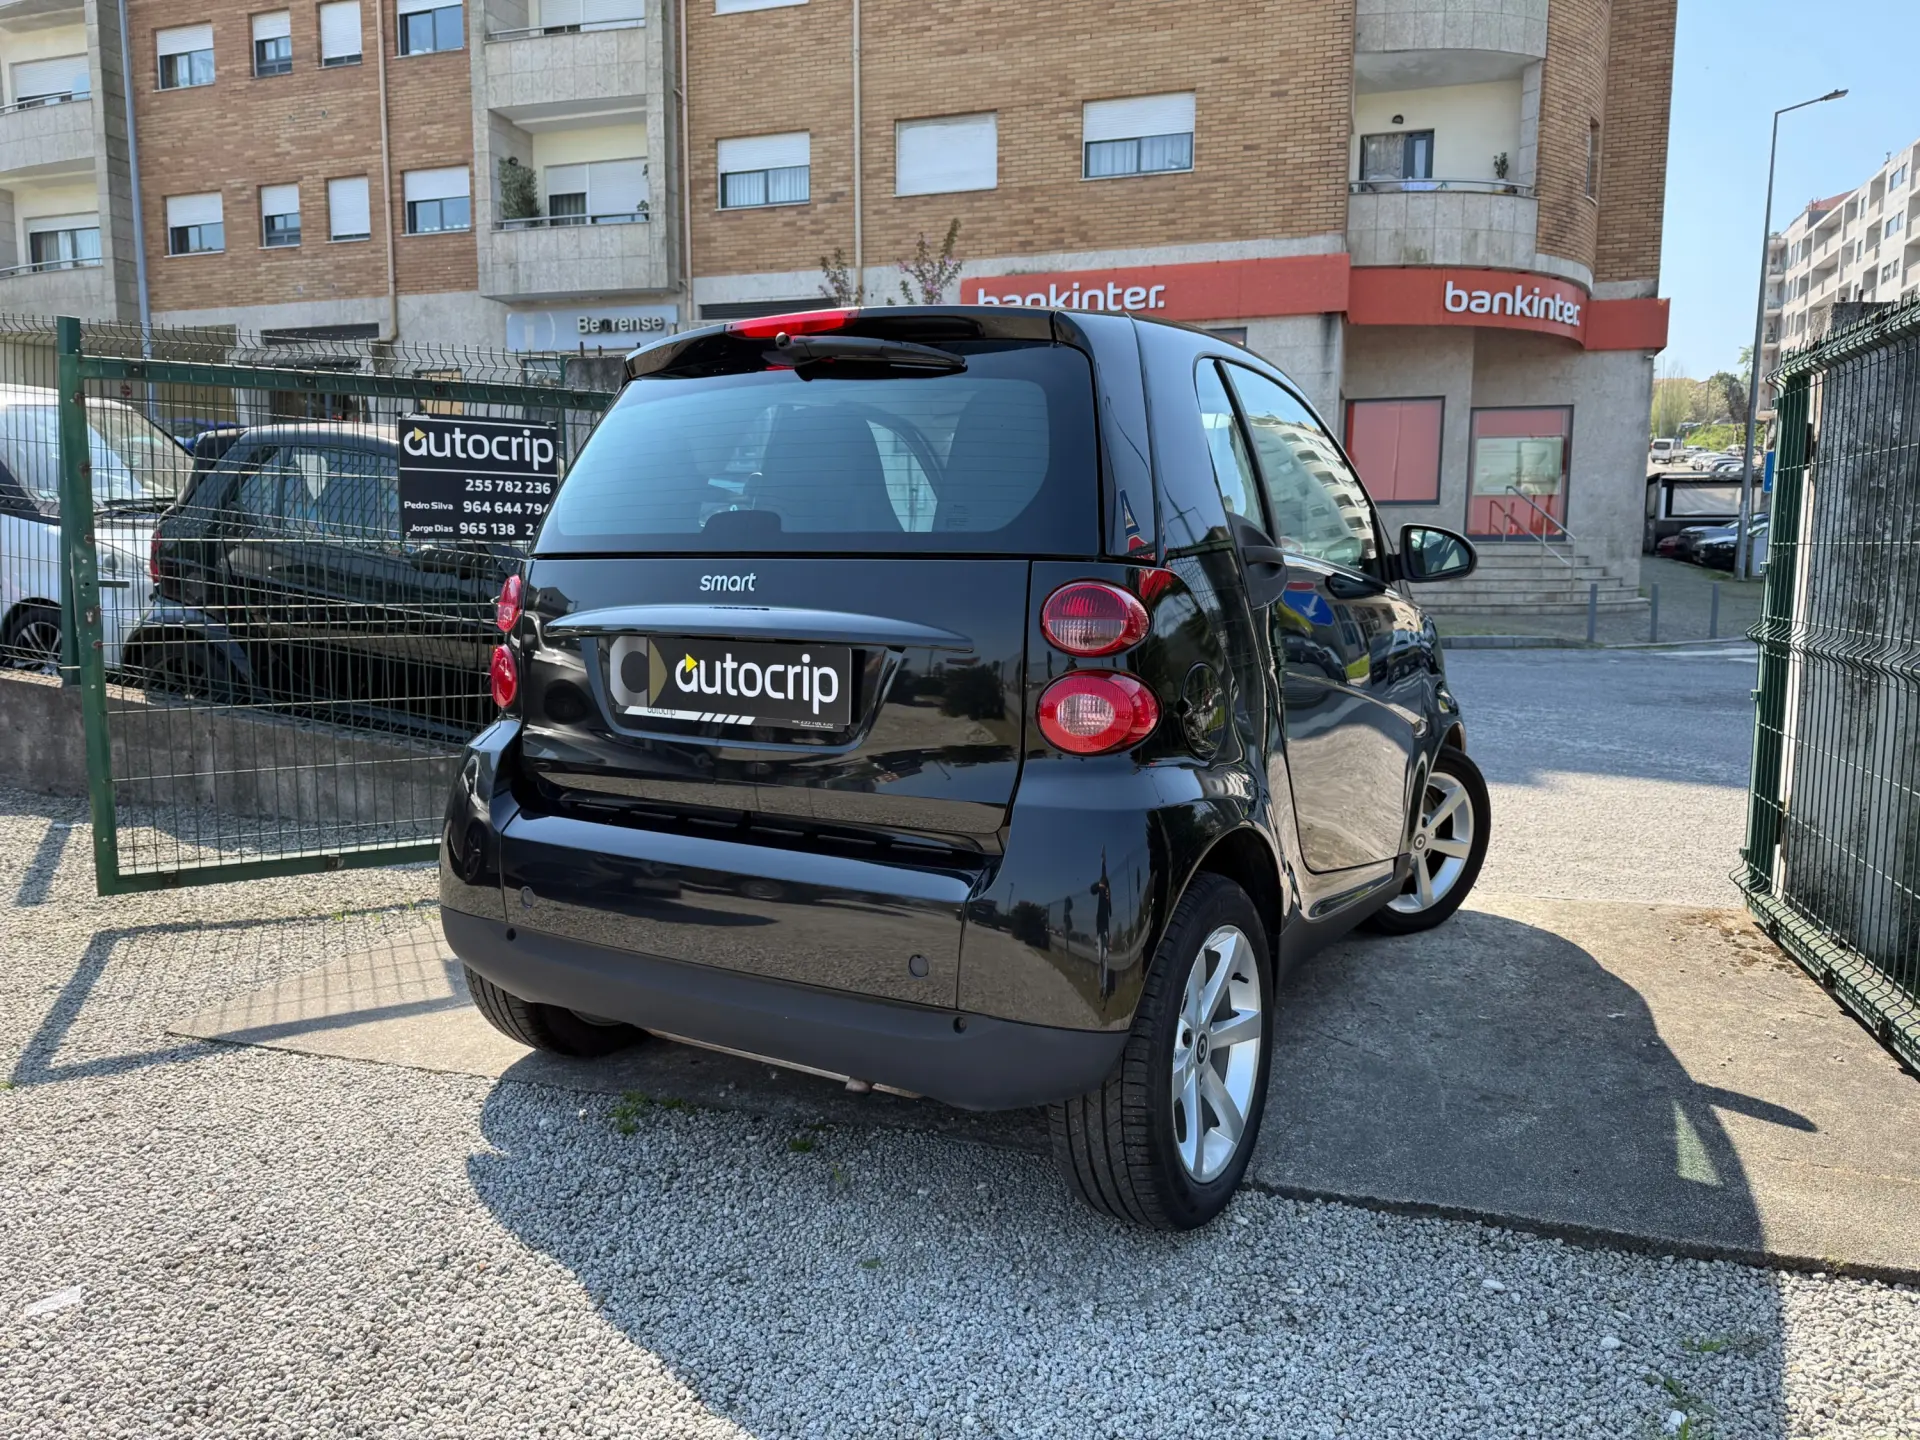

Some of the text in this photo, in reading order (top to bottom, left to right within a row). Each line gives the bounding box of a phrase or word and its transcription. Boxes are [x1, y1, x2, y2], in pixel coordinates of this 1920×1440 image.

[1444, 280, 1581, 326] bankinter.
[403, 427, 554, 471] autocrip
[465, 479, 551, 494] 255 782 236
[404, 501, 429, 510] Pedro
[431, 502, 454, 510] Silva
[463, 501, 491, 514] 964
[494, 502, 522, 514] 644
[410, 524, 434, 534] Jorge
[434, 525, 454, 533] Dias
[459, 522, 487, 535] 965
[490, 523, 516, 536] 138
[699, 572, 757, 592] smart
[675, 653, 839, 715] autocrip
